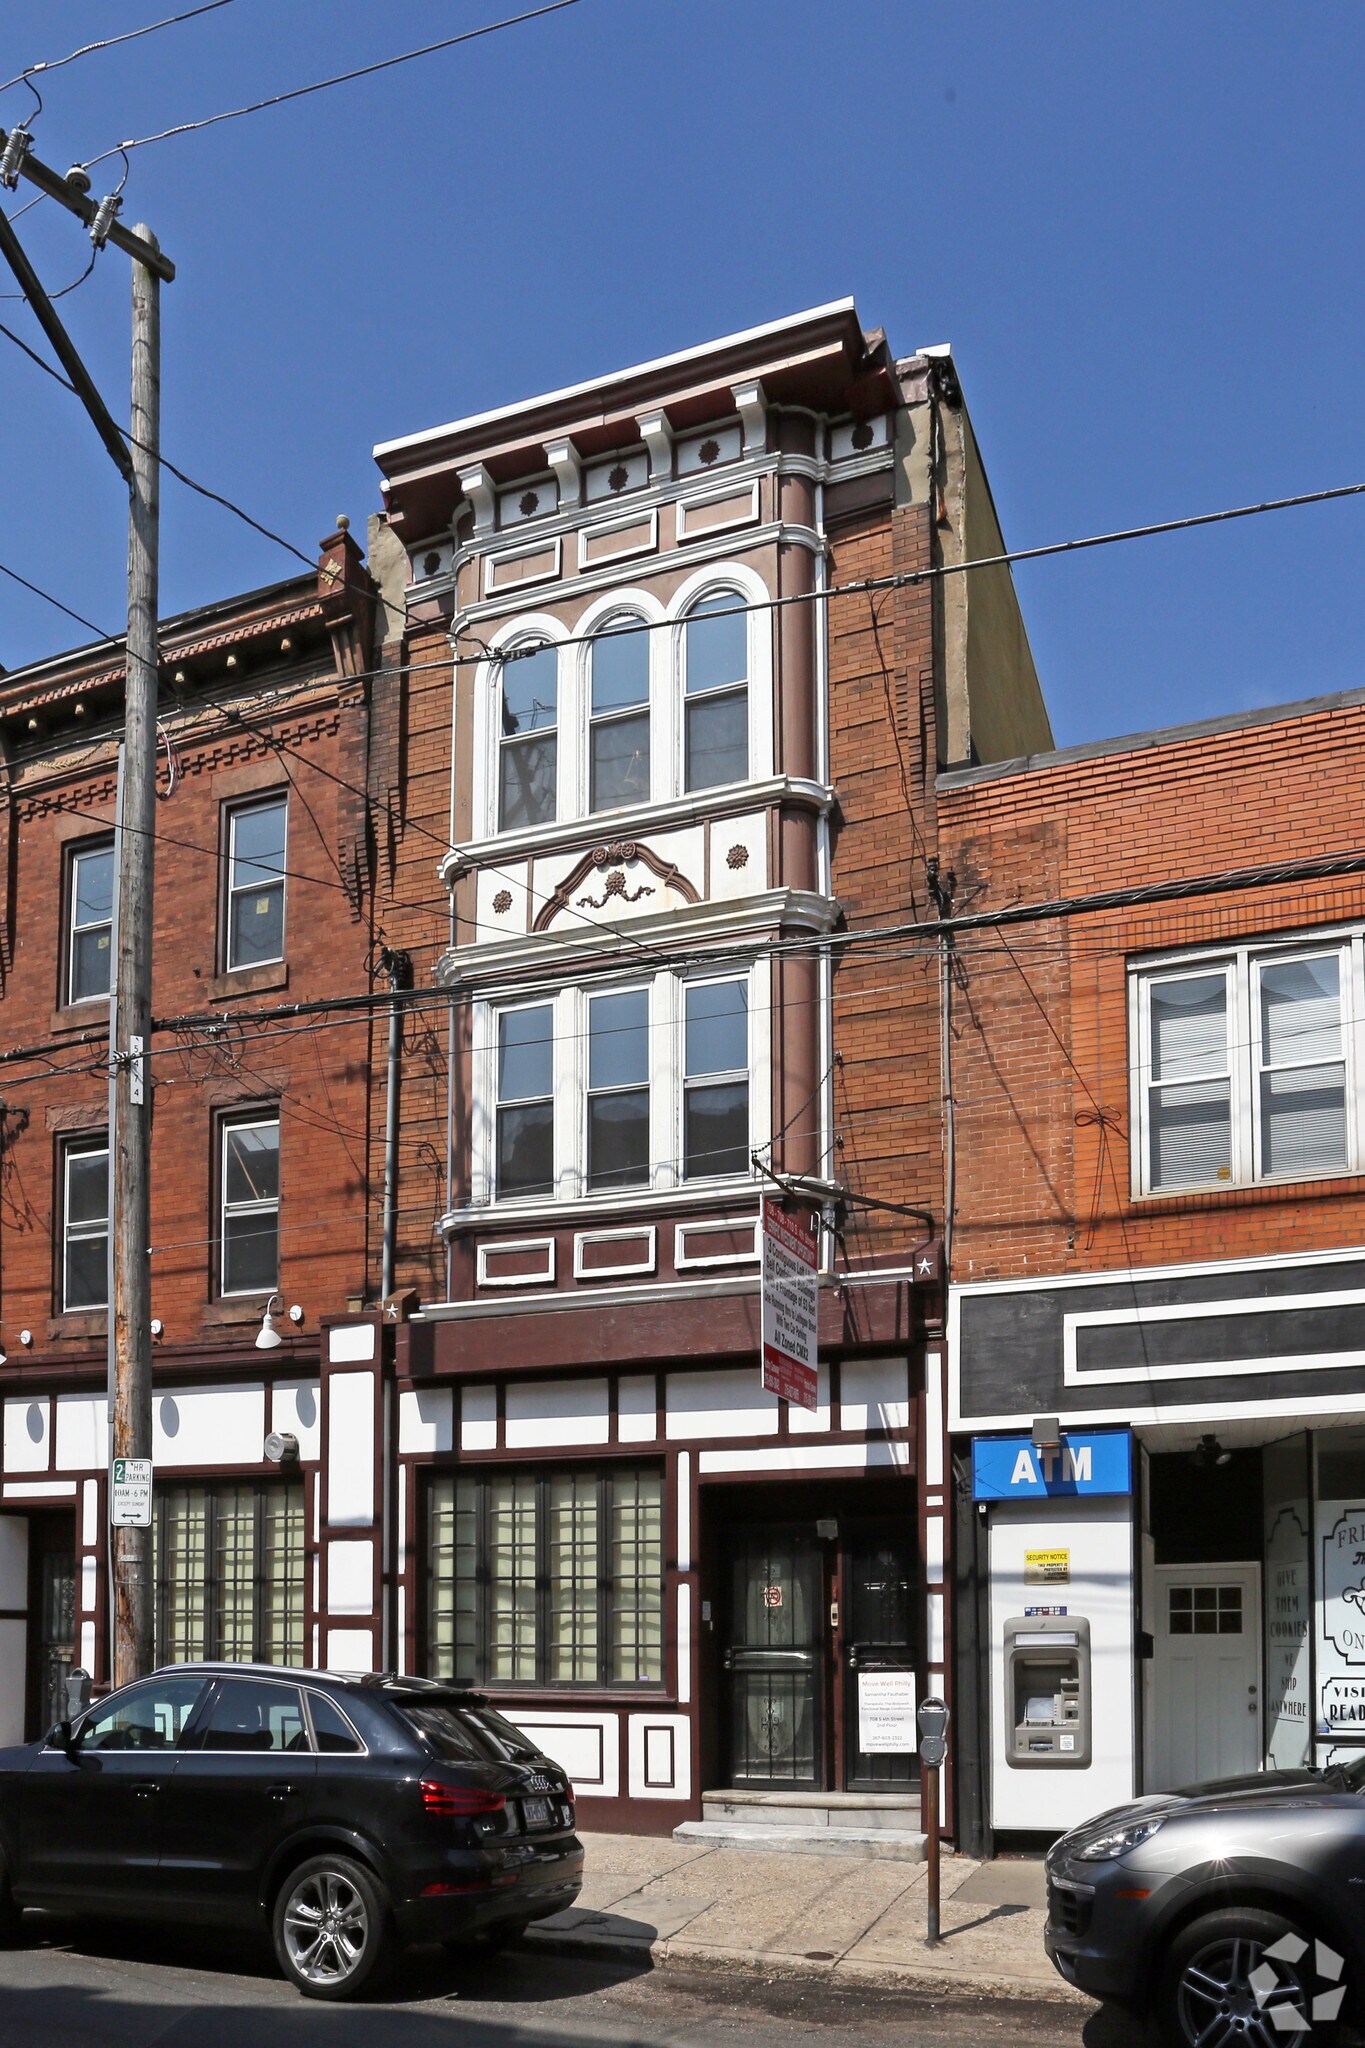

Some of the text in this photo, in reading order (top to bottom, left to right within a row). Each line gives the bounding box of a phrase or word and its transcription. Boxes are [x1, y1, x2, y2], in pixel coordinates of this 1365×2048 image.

[767, 1236, 771, 1253] 3
[772, 1241, 795, 1275] Contiguous
[779, 1280, 797, 1307] Frontage
[795, 1324, 806, 1344] Parking
[781, 1332, 795, 1354] Zoned
[116, 1463, 144, 1480] 2 HR
[1011, 1446, 1092, 1484] ATM
[126, 1474, 150, 1482] PARKING
[1276, 1569, 1297, 1588] GIVE
[1275, 1596, 1299, 1613] THEM
[1270, 1620, 1308, 1638] COOKIES
[1284, 1653, 1294, 1667] WE
[894, 1680, 911, 1688] Philly
[1280, 1676, 1297, 1691] SHIP
[1271, 1700, 1307, 1717] ANYWHERE
